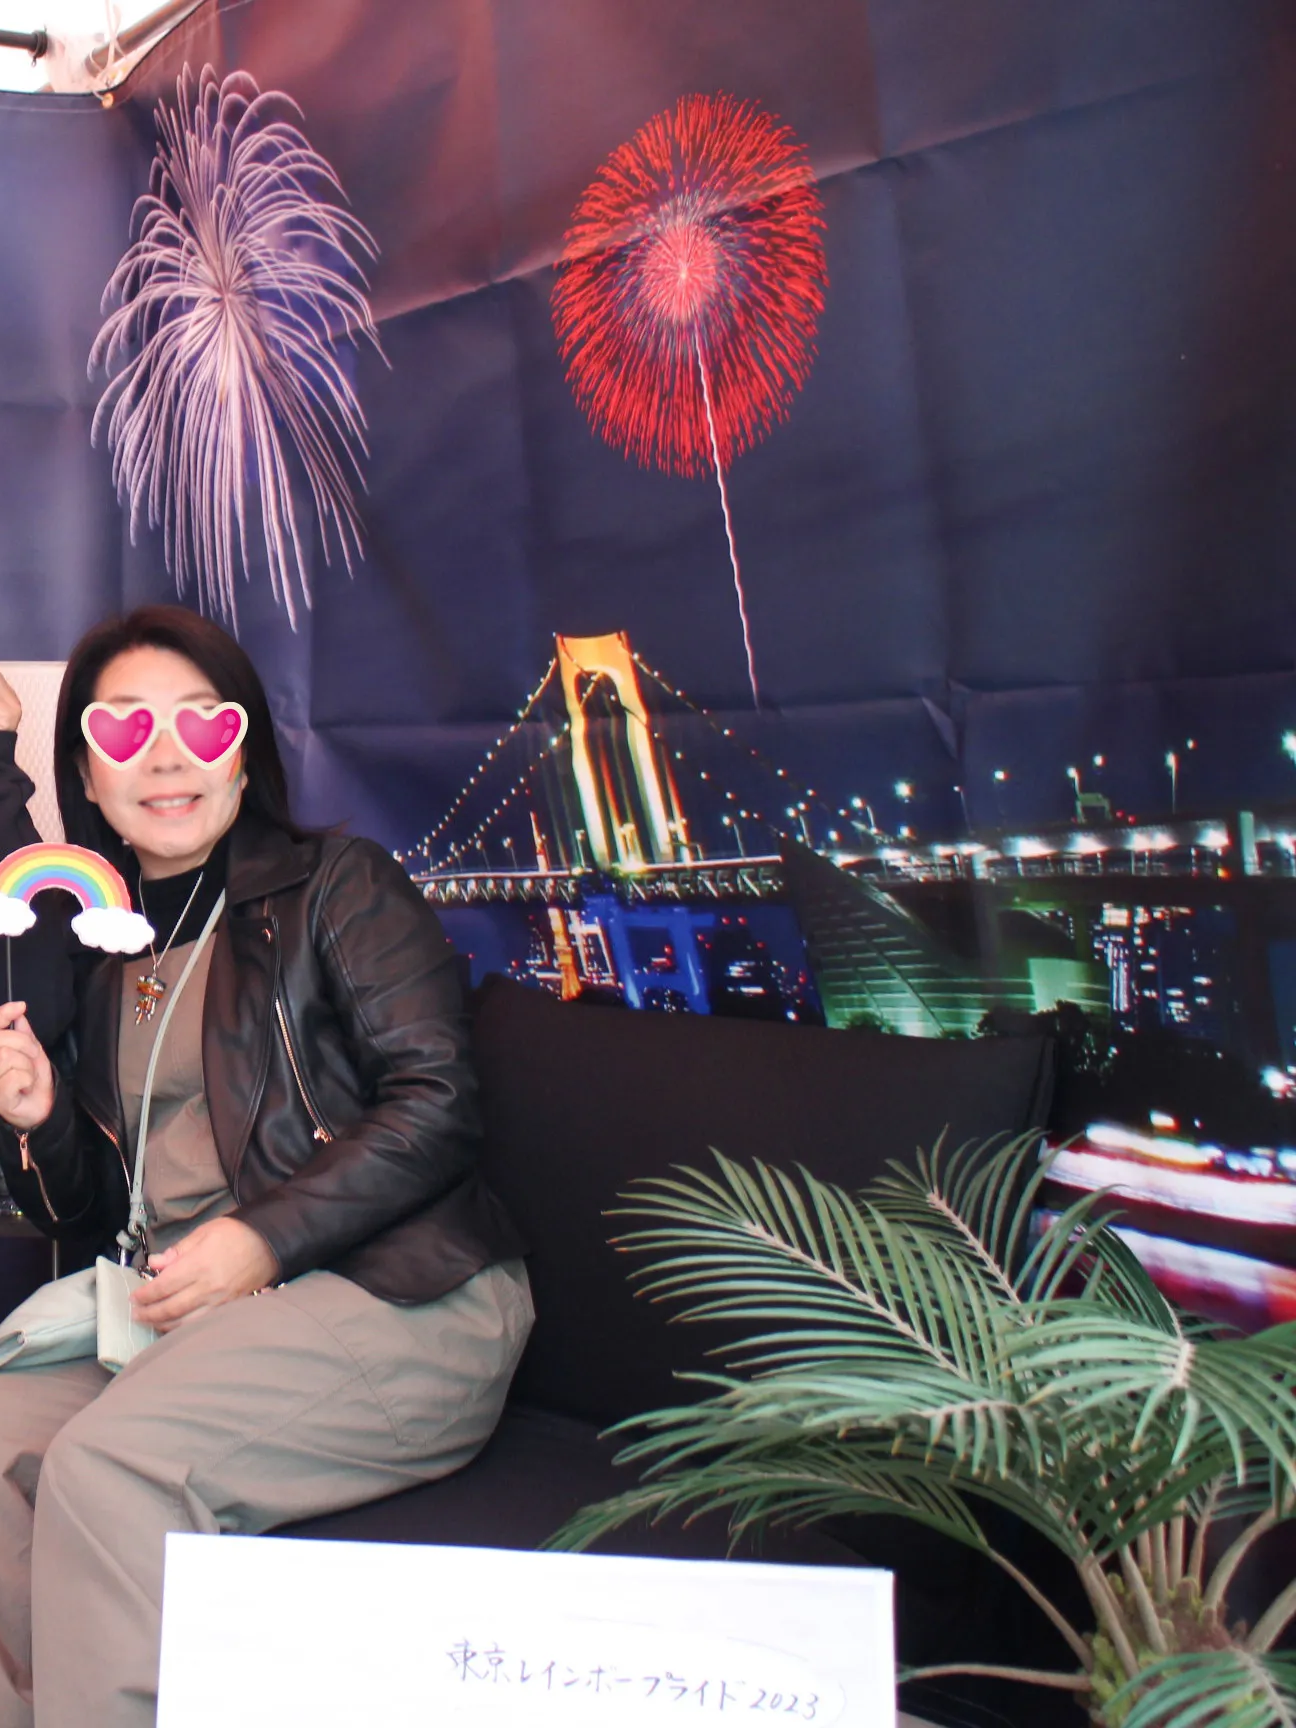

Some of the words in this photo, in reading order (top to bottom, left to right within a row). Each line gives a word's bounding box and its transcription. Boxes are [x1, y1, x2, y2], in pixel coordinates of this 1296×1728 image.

[446, 1637, 747, 1711] 東京レインボープライド
[749, 1688, 820, 1721] 2023
